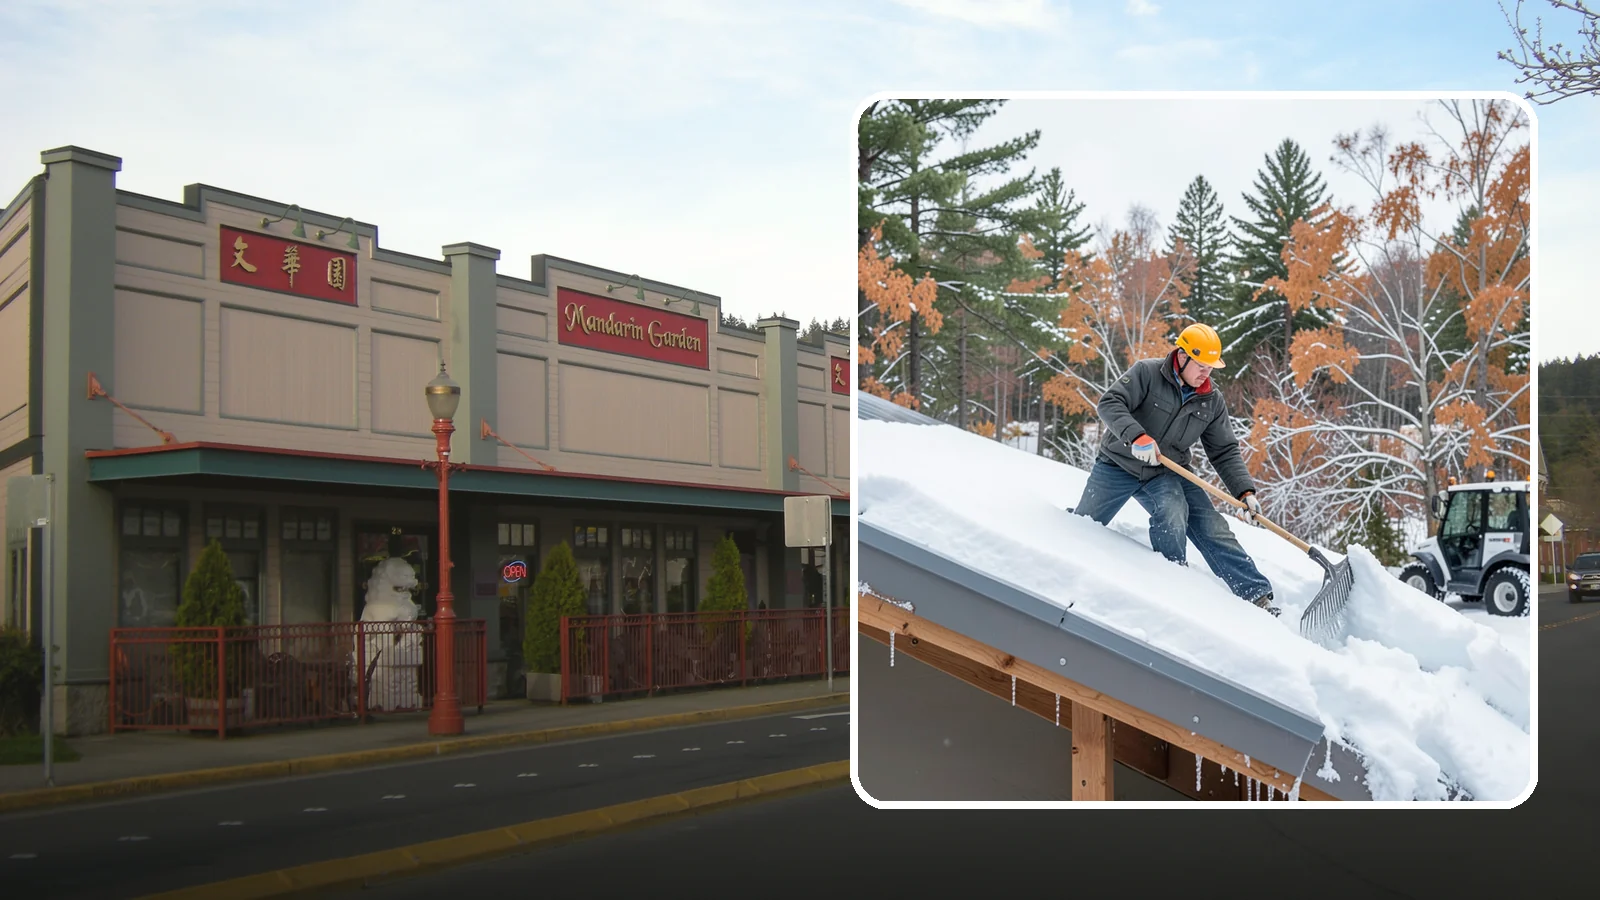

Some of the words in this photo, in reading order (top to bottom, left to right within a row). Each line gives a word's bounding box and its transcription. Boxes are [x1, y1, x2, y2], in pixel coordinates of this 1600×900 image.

[564, 302, 644, 340] Mandarin
[648, 320, 701, 352] Garden
[503, 565, 527, 578] OPEN
